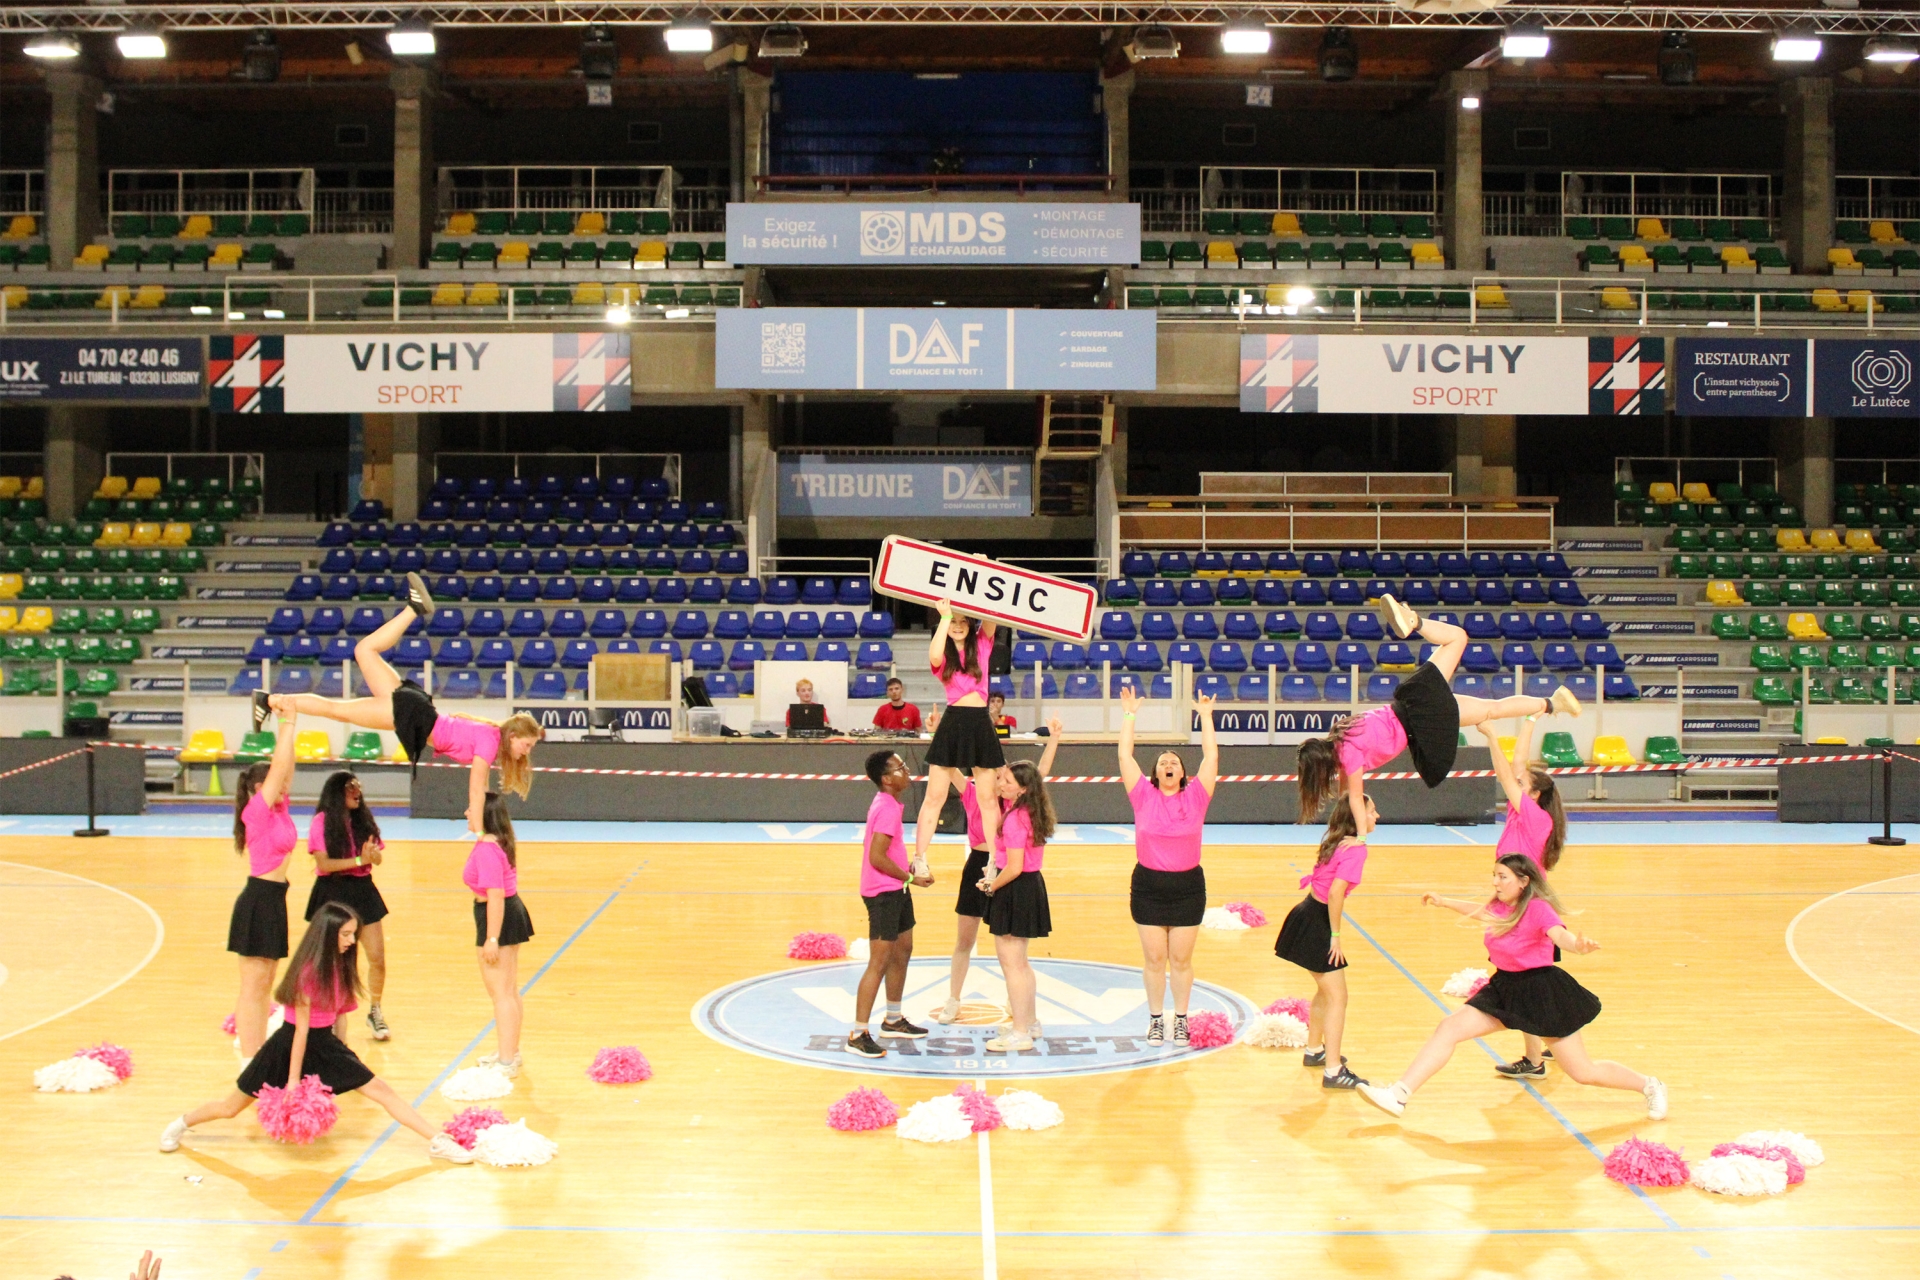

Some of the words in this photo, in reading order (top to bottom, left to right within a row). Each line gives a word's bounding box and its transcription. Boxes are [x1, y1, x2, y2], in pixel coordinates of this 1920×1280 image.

[1041, 210, 1106, 221] MONTAGE
[764, 217, 816, 234] Exigez
[909, 211, 1007, 243] MDS
[1040, 226, 1124, 239] DÉMONTAGE
[743, 235, 757, 248] la
[761, 234, 827, 249] sécurité
[833, 234, 838, 248] !
[909, 245, 1006, 256] ÉCHAFAUDAGE
[1041, 244, 1108, 257] SÉCURITÉ
[889, 318, 984, 365] DAF
[78, 348, 97, 367] 04
[99, 348, 118, 367] 70
[119, 348, 138, 367] 42
[139, 348, 159, 367] 40
[160, 348, 179, 367] 46
[347, 342, 489, 371] VICHY
[1382, 343, 1526, 374] VICHY
[1695, 353, 1790, 366] RESTAURANT
[889, 368, 940, 376] CONFIANCE
[942, 368, 955, 376] EN
[957, 368, 978, 376] TOIT
[1071, 361, 1113, 369] ZINGUERIE
[73, 371, 85, 385] LE
[87, 371, 122, 385] TUREAU
[129, 371, 160, 385] 03230
[161, 371, 199, 385] LUSIGNY
[1704, 378, 1738, 386] L'instant
[1739, 378, 1779, 389] vichyssois
[378, 385, 462, 404] SPORT
[1413, 387, 1498, 406] SPORT
[1729, 388, 1777, 398] parenthèses
[1852, 396, 1867, 407] Le
[1870, 395, 1910, 407] Lutèce
[791, 474, 913, 498] TRIBUNE
[943, 463, 1021, 500] DAF
[928, 560, 1048, 612] ENSIC
[953, 1059, 1009, 1069] 1914
